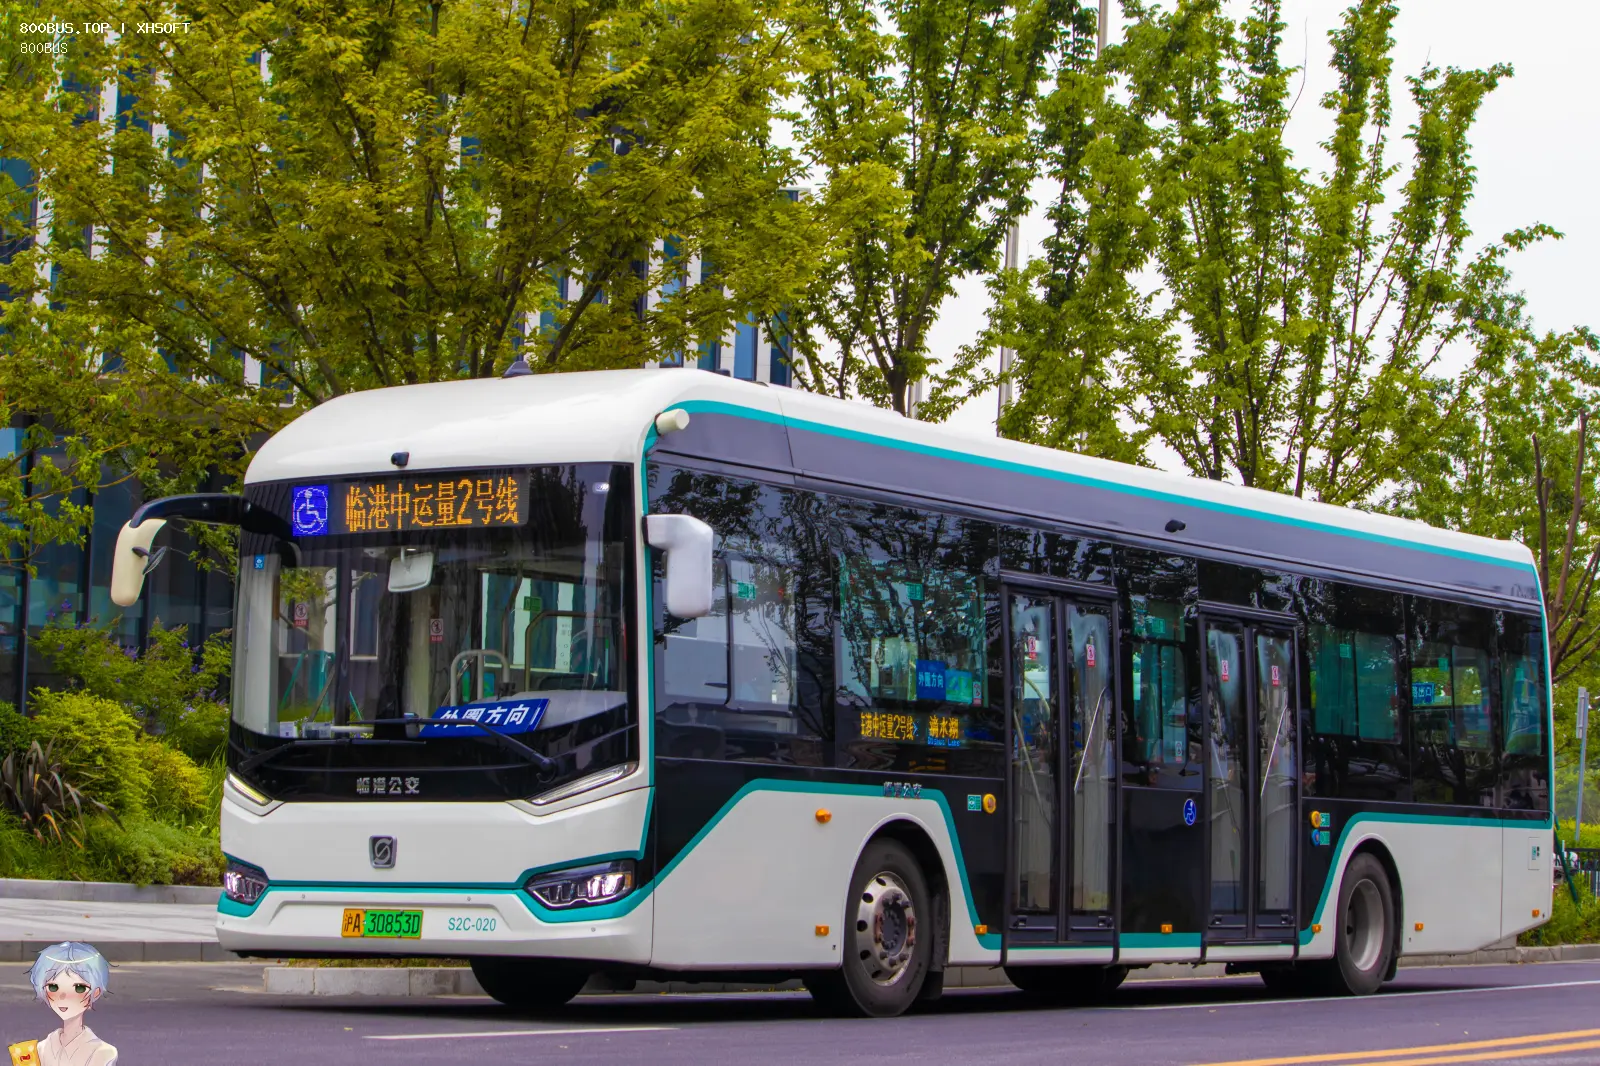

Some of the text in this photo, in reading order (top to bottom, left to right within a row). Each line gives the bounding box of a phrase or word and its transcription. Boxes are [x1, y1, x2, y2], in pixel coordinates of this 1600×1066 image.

[345, 476, 519, 532] 临港中运量2号线
[928, 714, 959, 739] 滴水湖
[356, 776, 420, 794] 临港公交
[447, 917, 497, 932] S2C-020
